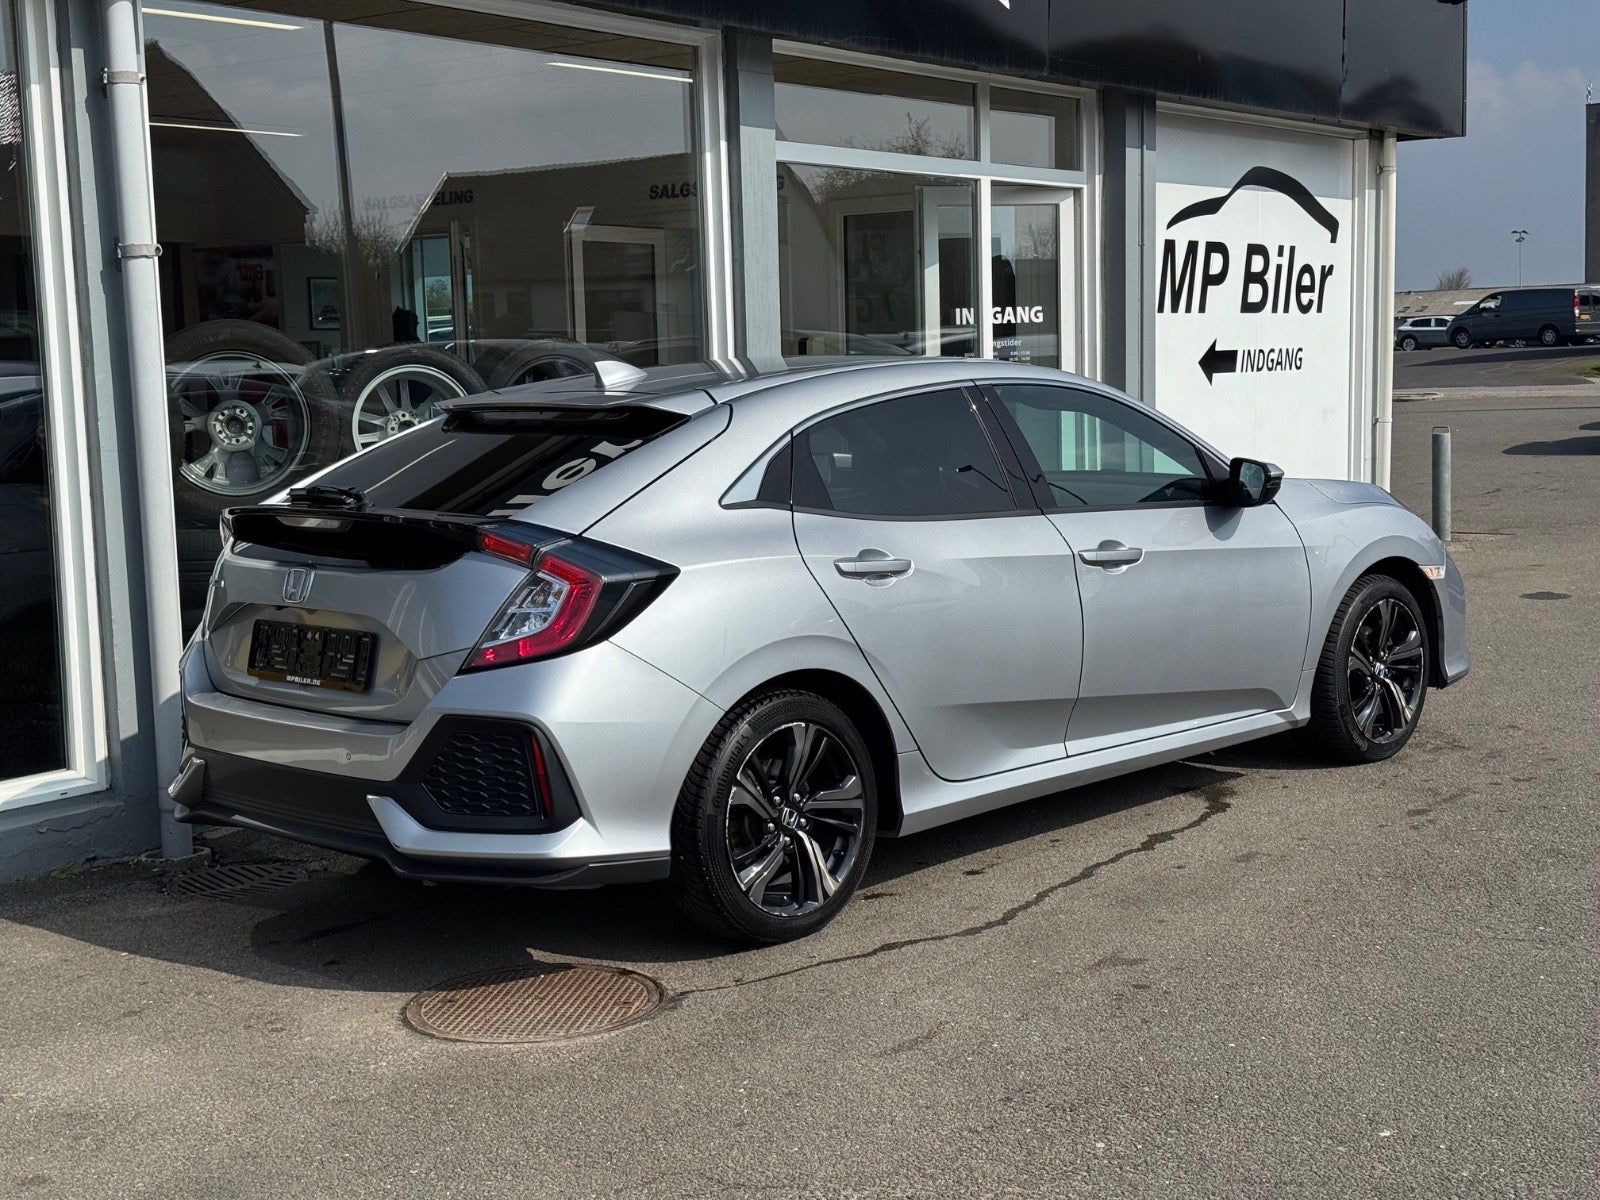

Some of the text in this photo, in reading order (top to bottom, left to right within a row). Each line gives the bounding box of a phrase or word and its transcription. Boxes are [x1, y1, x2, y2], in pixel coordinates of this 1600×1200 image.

[1157, 238, 1333, 314] MP Biler
[955, 306, 1043, 325] INGANG
[1241, 347, 1303, 373] INDGANG
[711, 741, 745, 810] Continental
